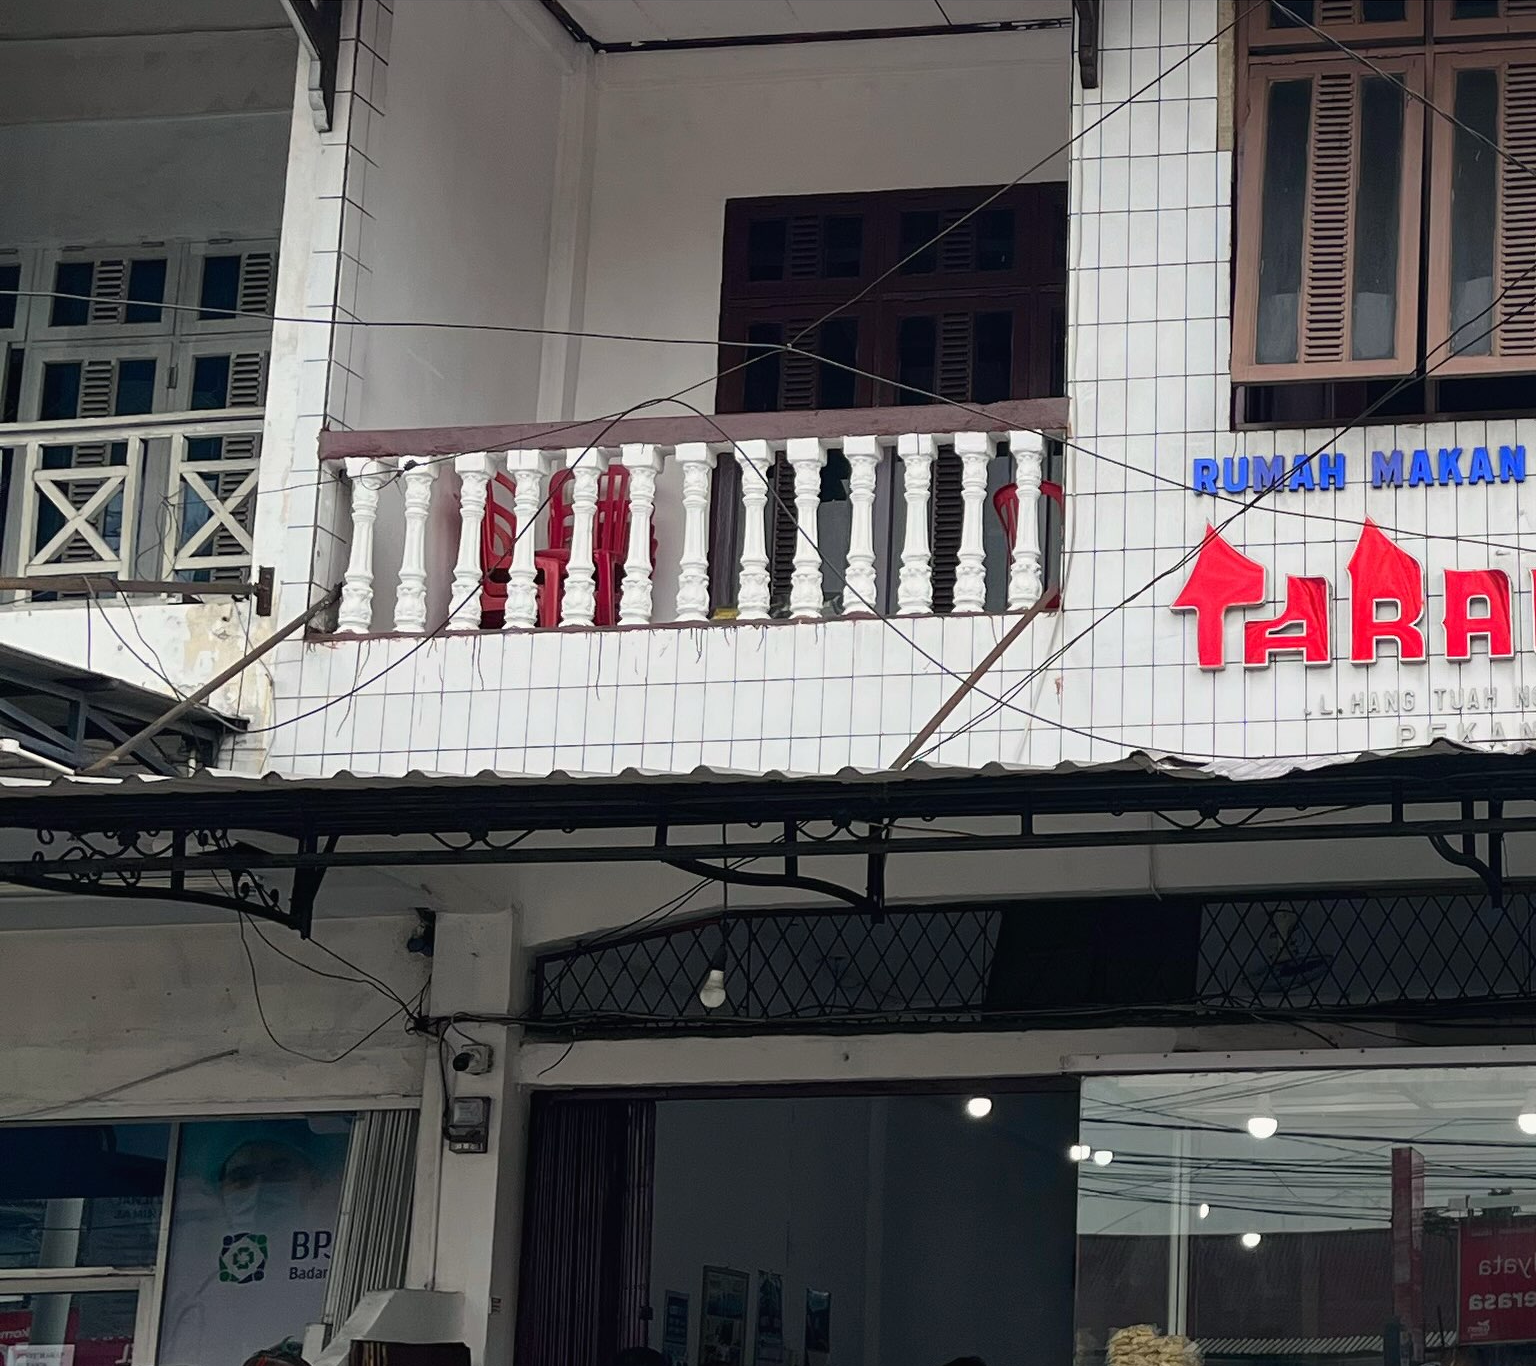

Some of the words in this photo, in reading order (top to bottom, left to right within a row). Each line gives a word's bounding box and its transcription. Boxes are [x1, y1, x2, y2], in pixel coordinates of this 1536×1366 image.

[1193, 451, 1346, 496] RUMAH
[1371, 444, 1526, 490] MAKAN
[1433, 686, 1498, 711] TUAH
